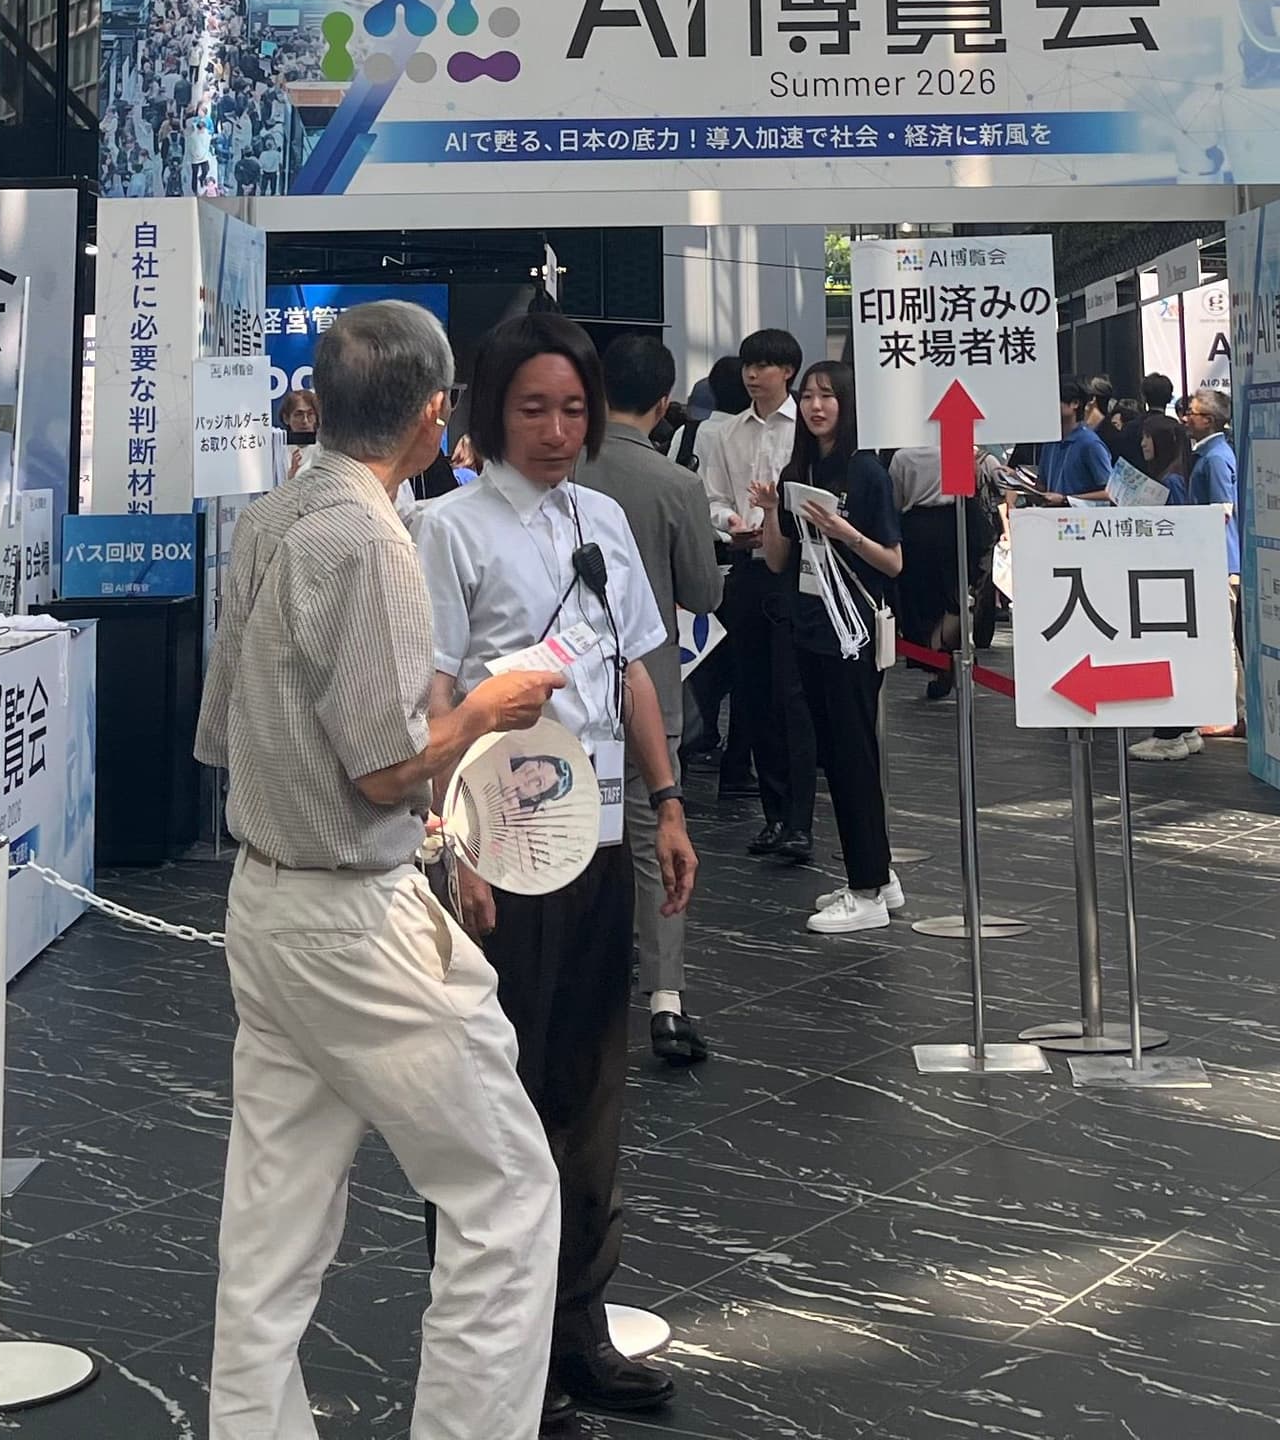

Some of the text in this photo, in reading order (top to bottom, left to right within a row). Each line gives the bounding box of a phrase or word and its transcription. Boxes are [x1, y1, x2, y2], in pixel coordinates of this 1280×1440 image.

[770, 68, 996, 100] Summer 2026
[444, 122, 1052, 152] AIで甦る、日本の底力！導入加速で社会・経済に新風を
[928, 247, 1007, 268] AI博覧会
[859, 285, 1051, 326] 印刷済みの
[879, 325, 1037, 368] 来場者様
[196, 413, 269, 430] バッジホルダーを
[200, 435, 266, 451] お取りください
[1092, 519, 1176, 539] AI博覧会
[65, 543, 192, 563] パス回収 BOX
[1042, 567, 1198, 641] 入口
